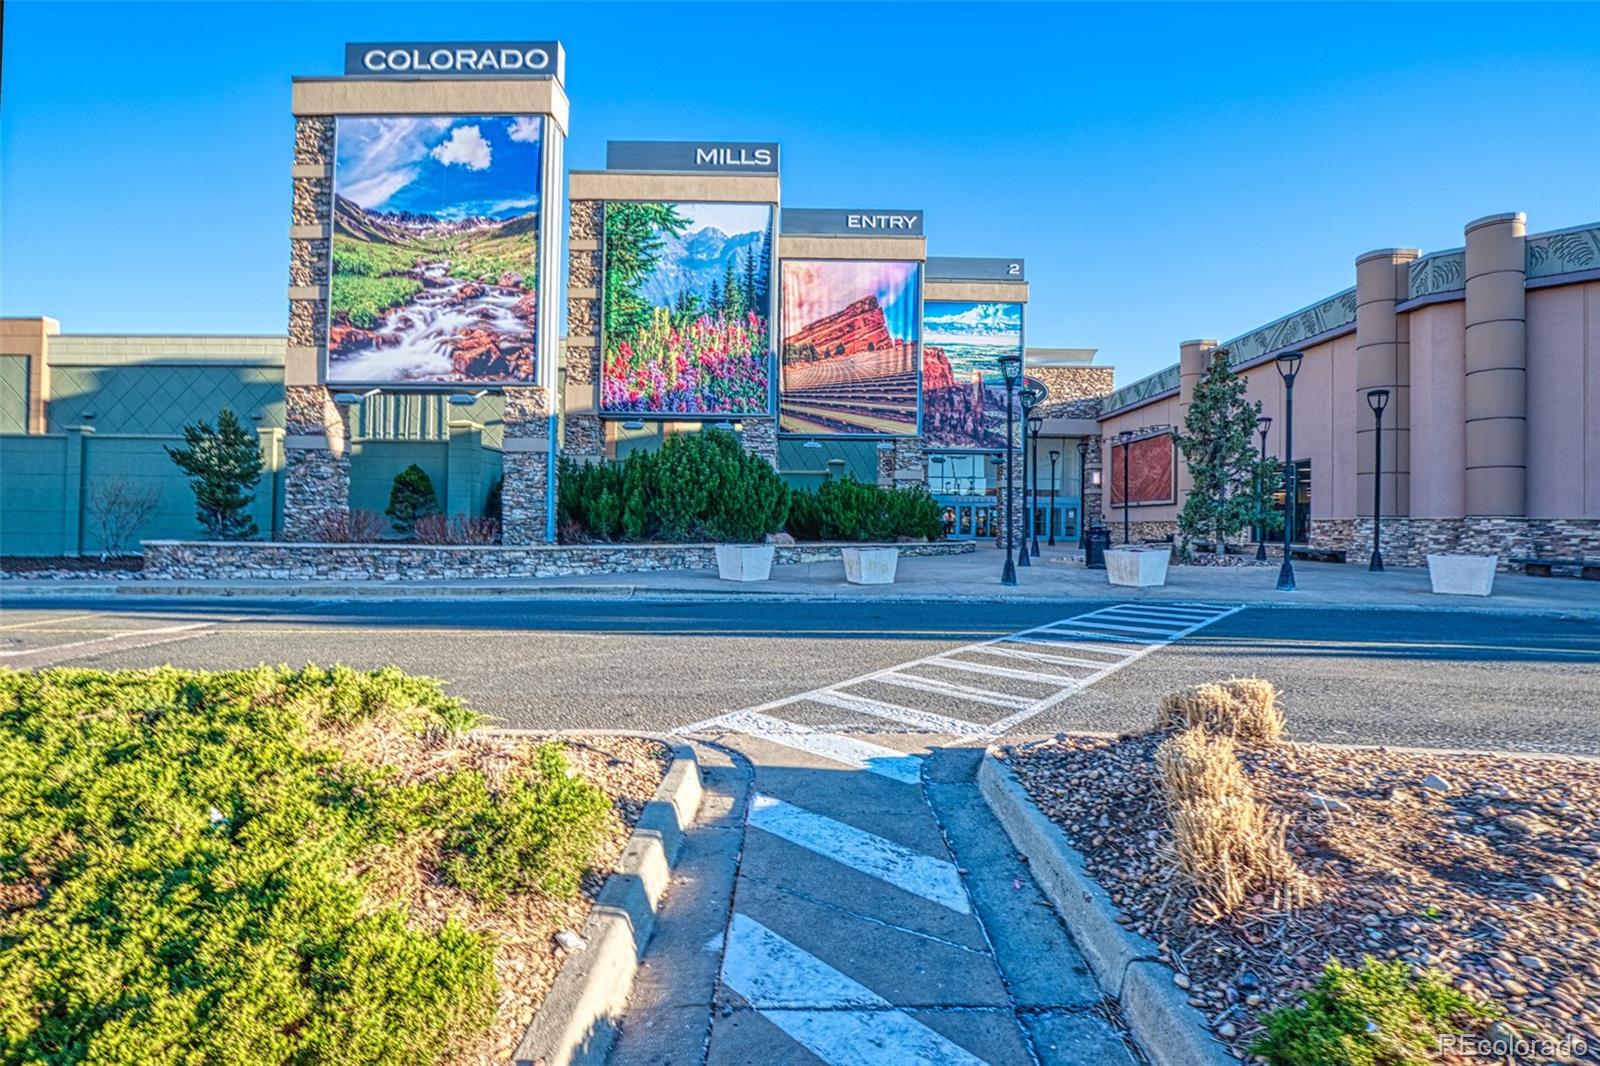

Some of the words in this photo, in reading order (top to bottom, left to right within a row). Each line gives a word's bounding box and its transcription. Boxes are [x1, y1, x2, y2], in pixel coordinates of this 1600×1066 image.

[363, 48, 550, 71] COLORADO
[695, 148, 772, 166] MILLS
[847, 215, 918, 229] ENTRY
[1009, 263, 1020, 274] 2
